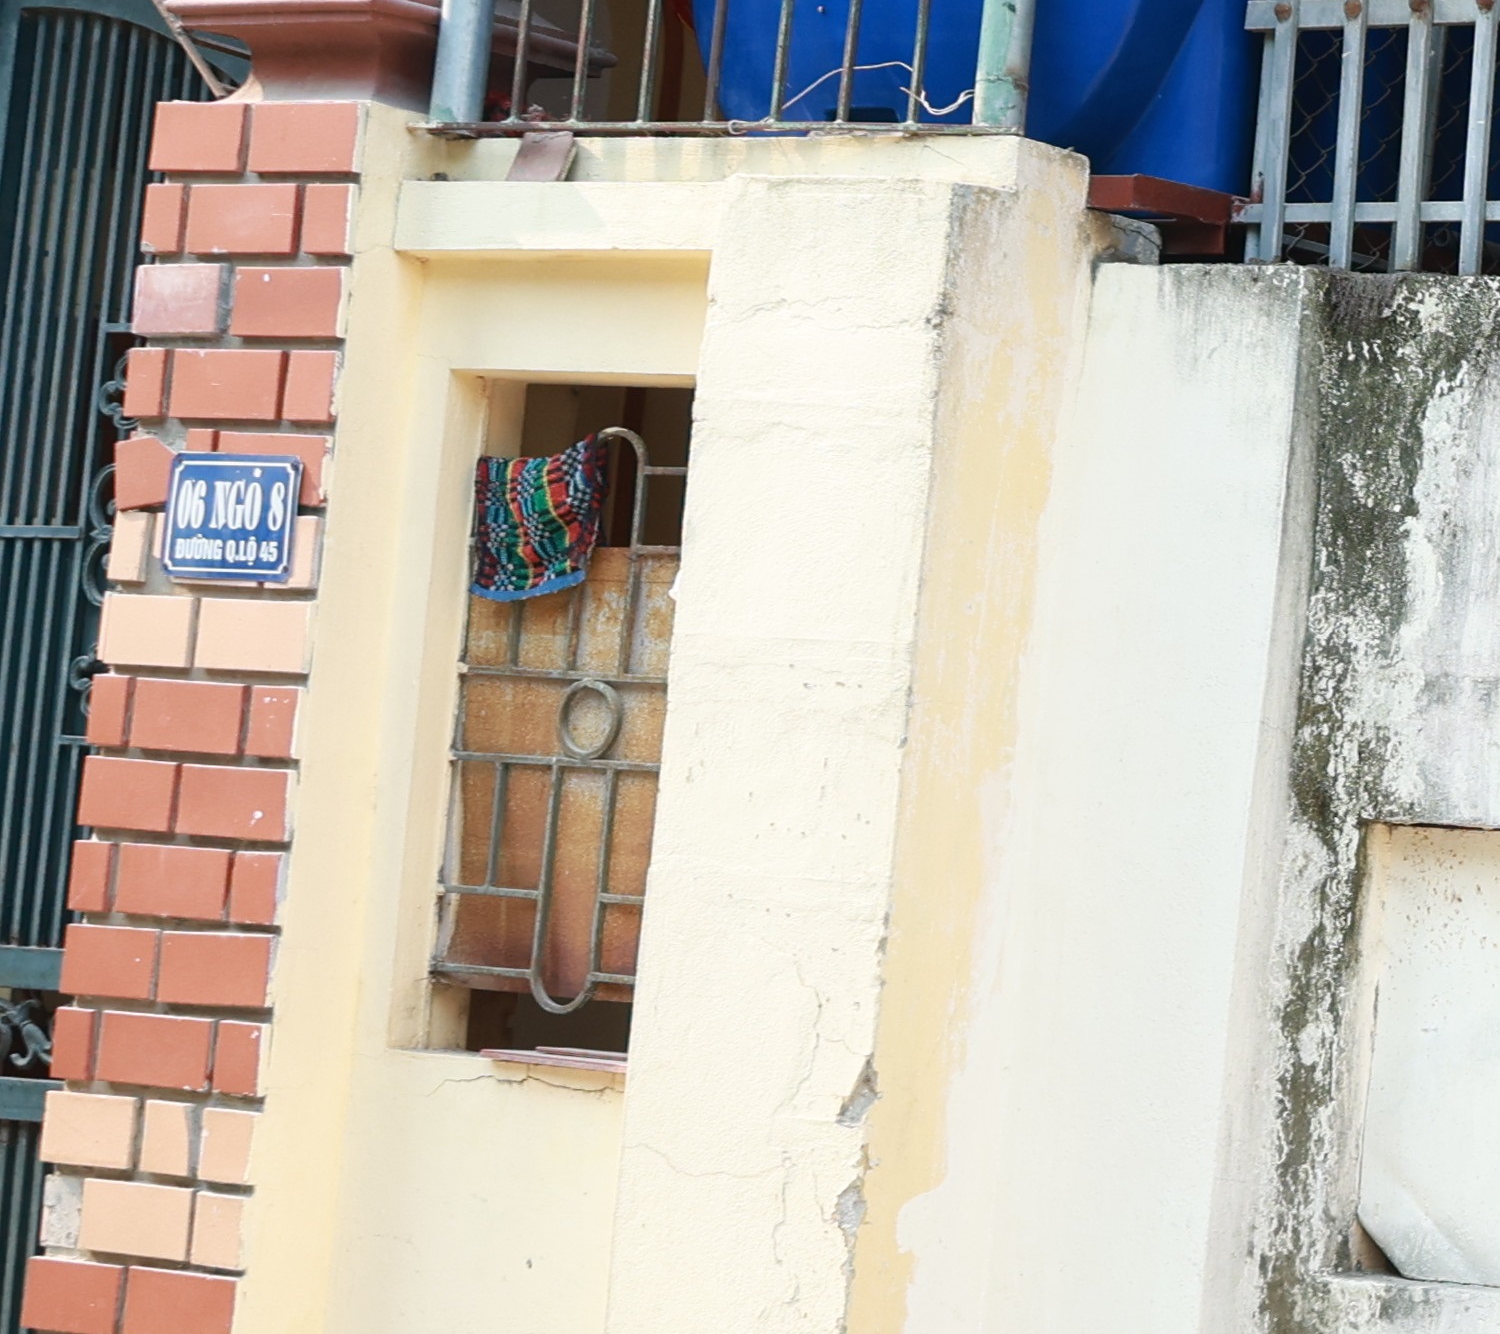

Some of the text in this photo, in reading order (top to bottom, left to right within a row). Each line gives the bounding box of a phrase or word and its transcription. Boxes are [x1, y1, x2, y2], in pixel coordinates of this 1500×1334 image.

[177, 479, 207, 529] 06
[267, 482, 285, 531] 8
[259, 541, 279, 562] 45
